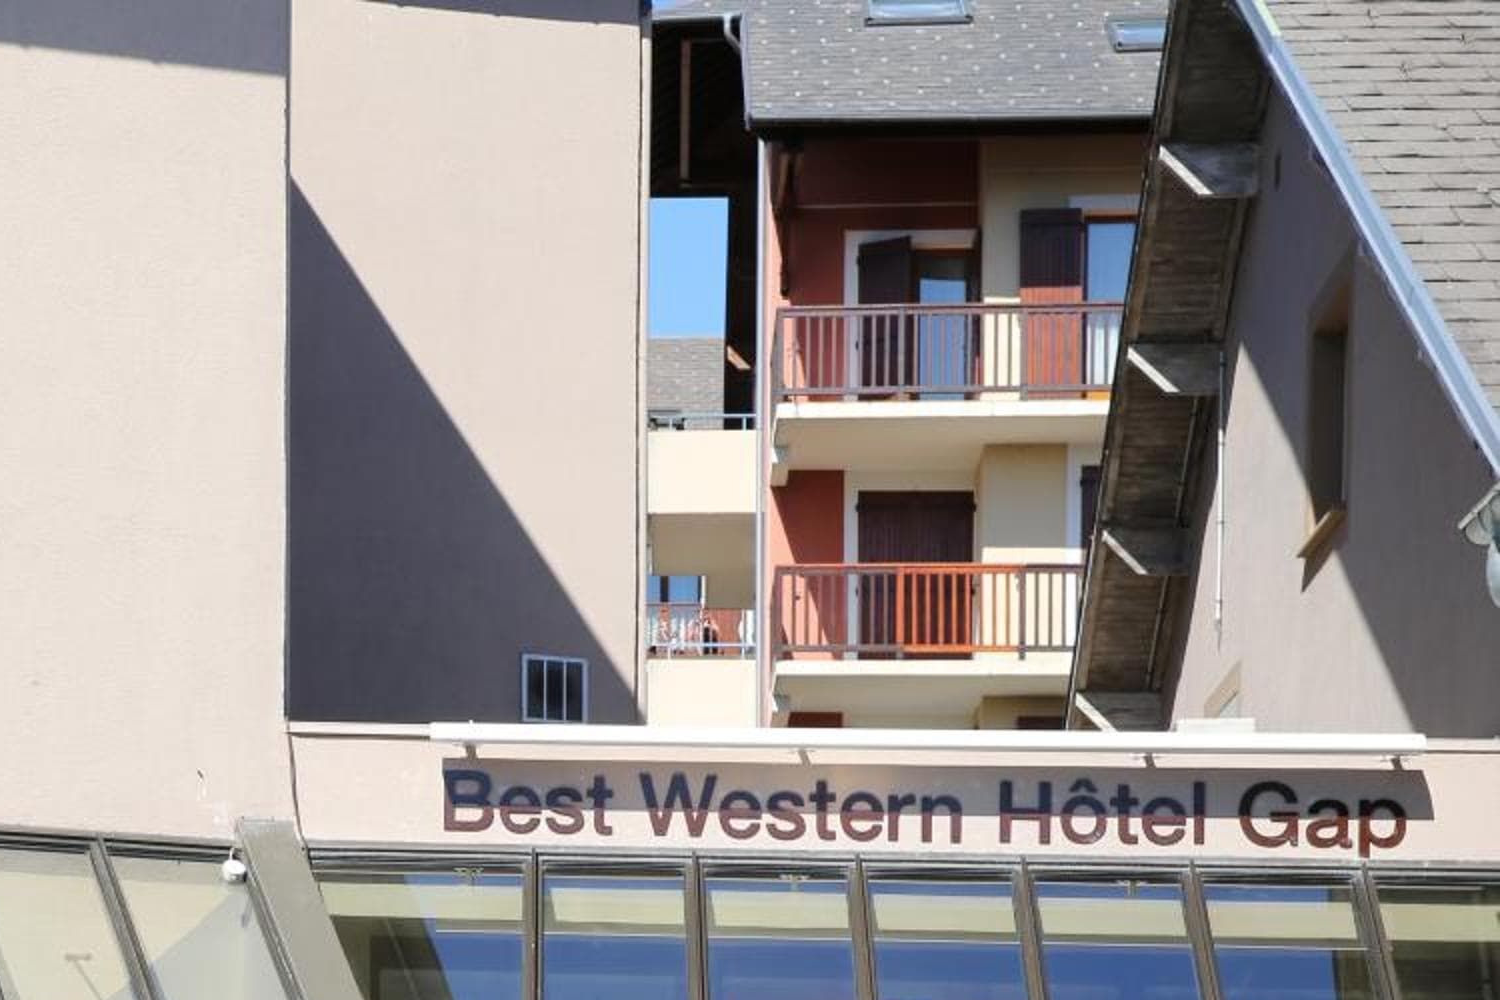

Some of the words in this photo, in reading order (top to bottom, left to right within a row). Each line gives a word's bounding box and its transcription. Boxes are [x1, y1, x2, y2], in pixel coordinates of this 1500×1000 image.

[443, 769, 613, 836] Best
[639, 772, 963, 842] Western
[999, 778, 1205, 846] Hôtel
[1238, 780, 1407, 858] Gap
